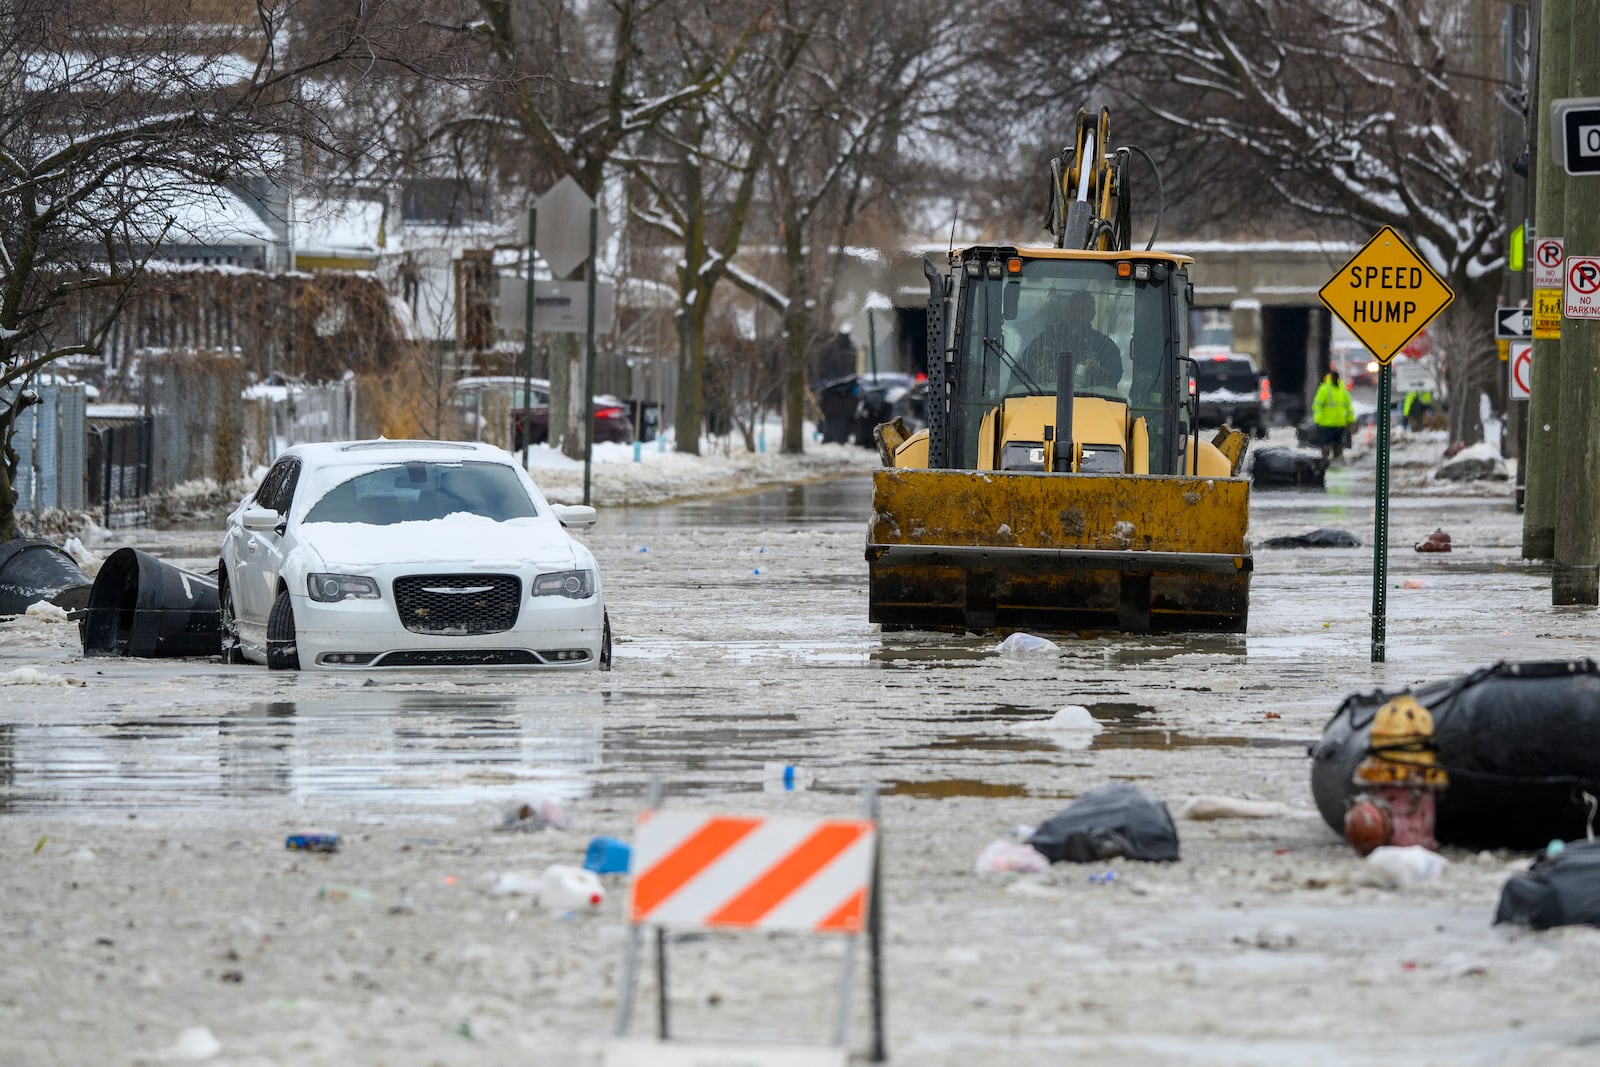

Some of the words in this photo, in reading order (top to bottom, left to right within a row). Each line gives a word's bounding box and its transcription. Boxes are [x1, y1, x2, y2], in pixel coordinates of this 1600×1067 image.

[1350, 266, 1422, 289] SPEED
[1537, 277, 1562, 285] PARKIN
[1580, 296, 1591, 305] NO
[1353, 300, 1416, 323] HUMP
